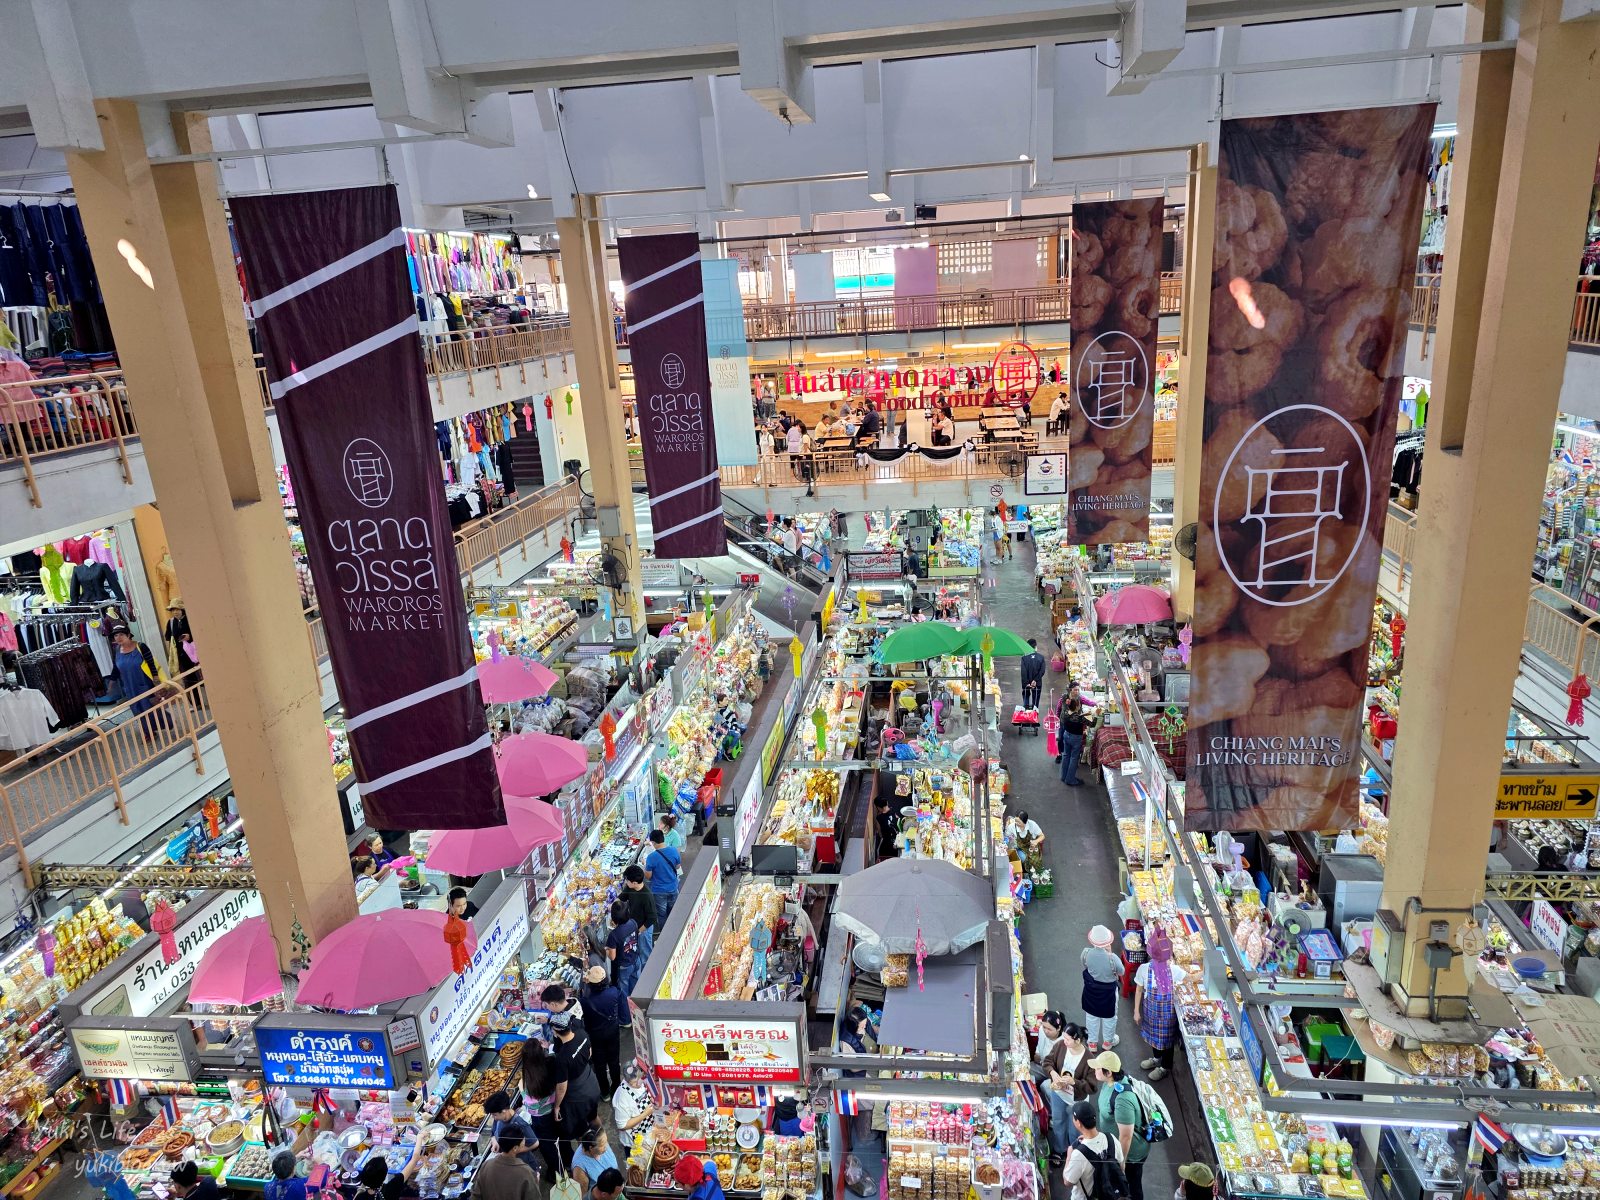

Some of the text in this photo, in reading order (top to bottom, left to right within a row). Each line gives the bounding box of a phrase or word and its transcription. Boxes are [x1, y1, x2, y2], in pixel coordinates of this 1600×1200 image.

[650, 392, 702, 412] ตลาด
[651, 411, 704, 433] วโรรส
[654, 432, 705, 443] WAROROS
[655, 442, 705, 453] MARKET
[1071, 502, 1101, 511] LIVING
[1077, 494, 1140, 503] CHIANG MAI'S
[328, 517, 433, 555] ตลาด
[335, 552, 439, 593] วโรรส
[343, 594, 443, 613] WAROROS
[349, 613, 444, 631] MARKET
[1210, 736, 1341, 752] CHIANG MAI'S
[1196, 750, 1350, 767] LIVING HERITAGE
[1503, 779, 1556, 796] ทางข้าม
[152, 988, 171, 1006] Tel.
[661, 1021, 789, 1041] ร้านศรีพรรณ
[290, 1031, 353, 1051] ดำรงค์
